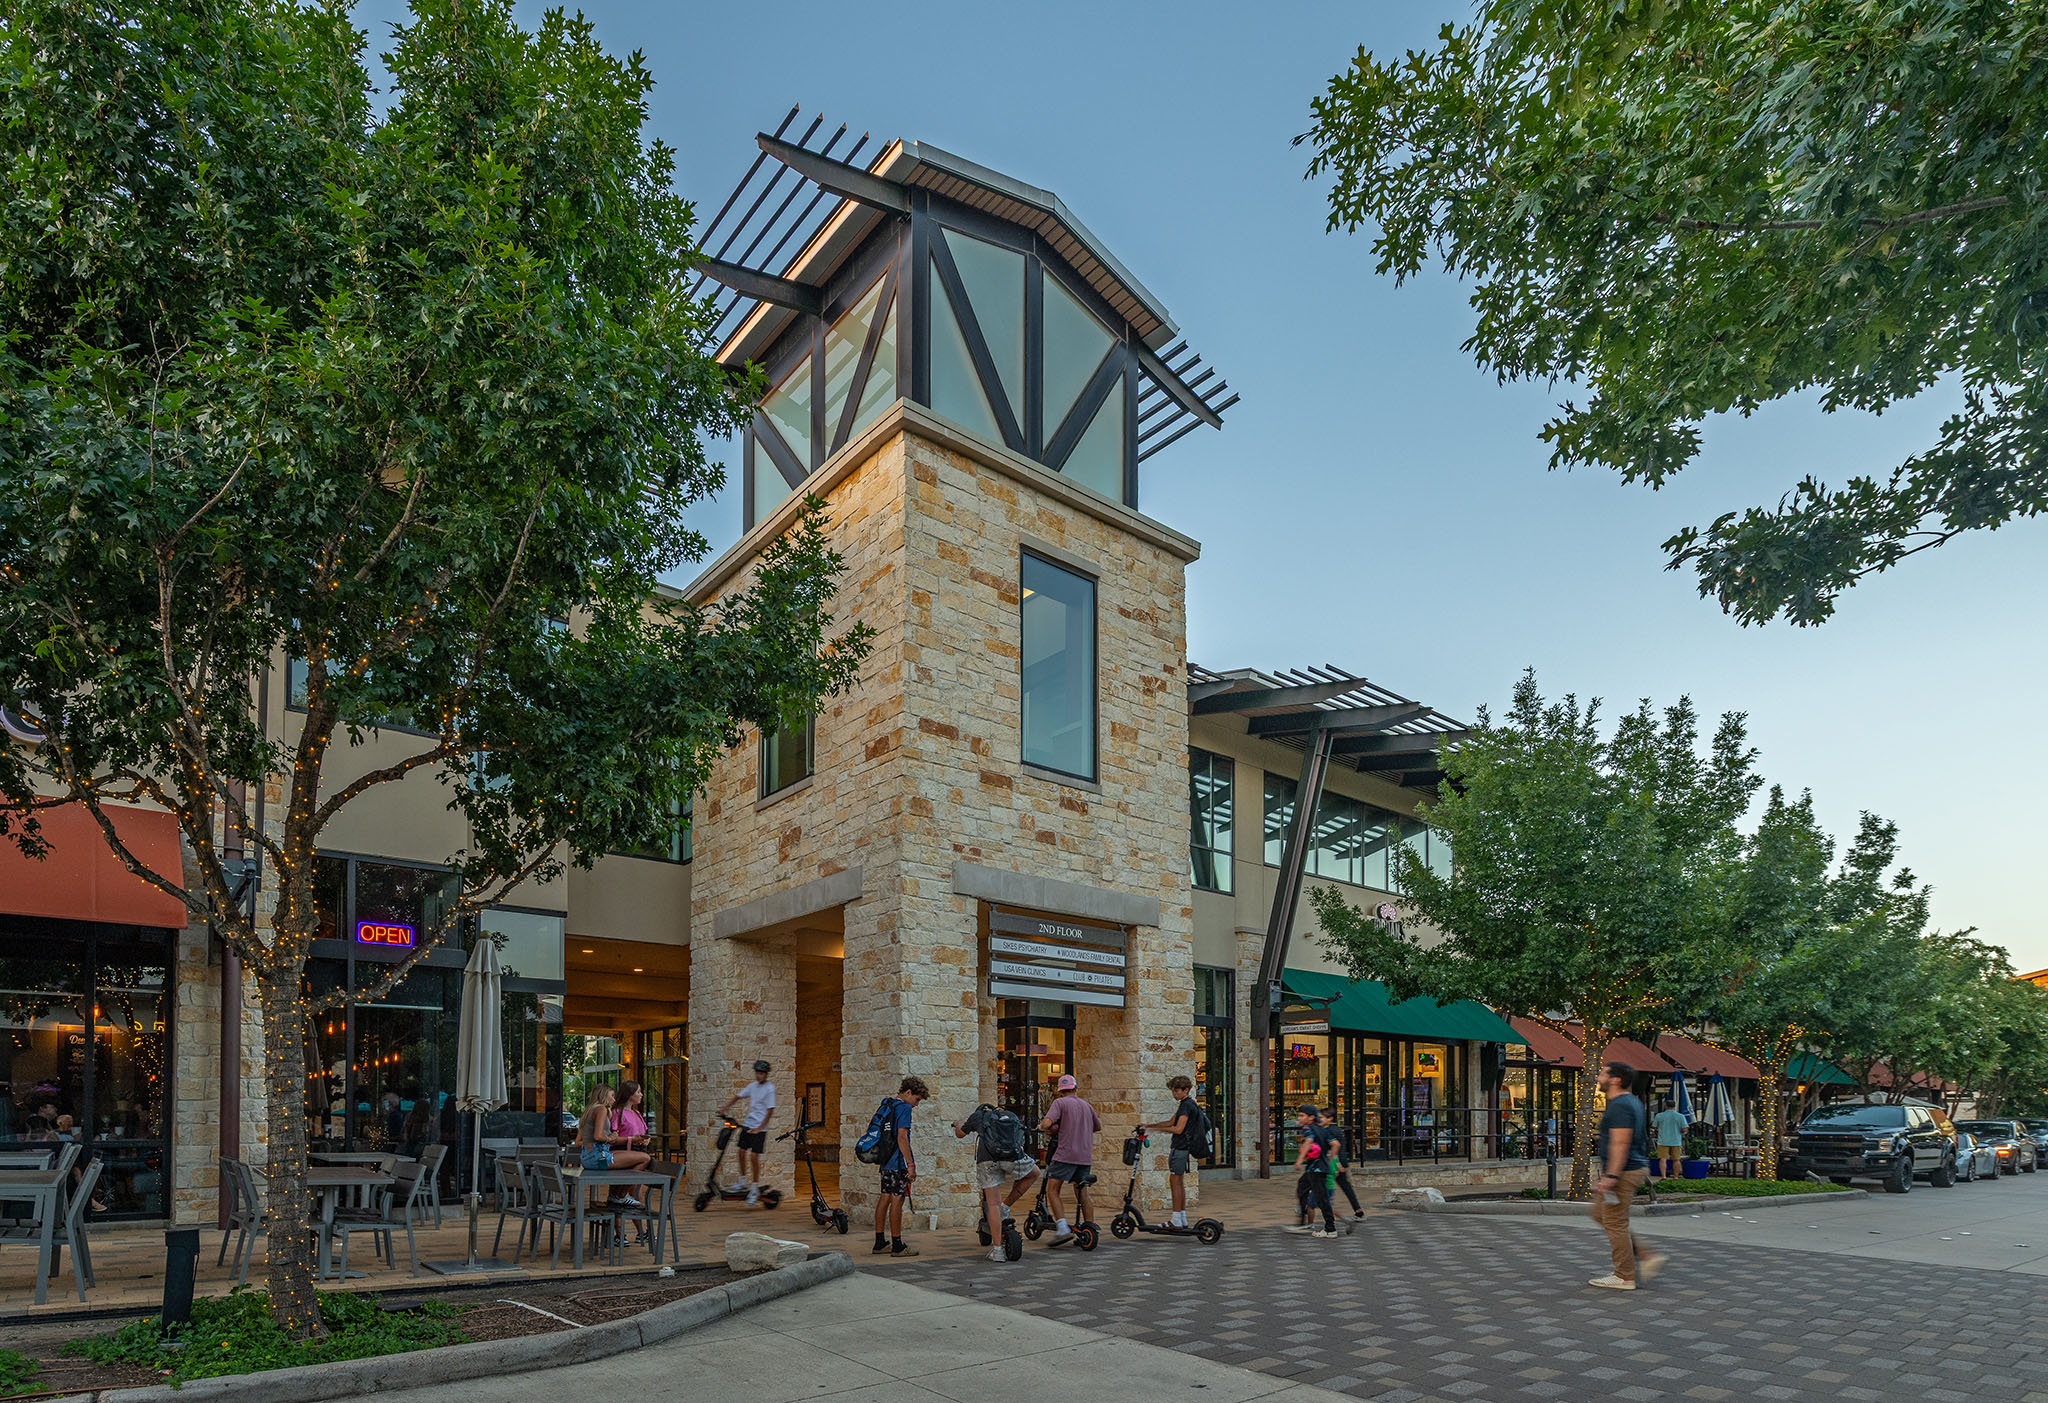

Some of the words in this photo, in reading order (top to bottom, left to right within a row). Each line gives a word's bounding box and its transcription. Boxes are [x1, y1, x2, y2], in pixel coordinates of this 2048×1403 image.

[360, 925, 410, 945] OPEN
[1038, 923, 1056, 935] 2ND
[1056, 926, 1083, 939] FLOOR
[1002, 941, 1018, 951] SIKES
[1018, 942, 1048, 954] PSYCHIATRY
[1060, 949, 1090, 961] WOODLANDS
[1090, 953, 1106, 962] FAMILY
[1105, 954, 1122, 965] DENTAL
[1003, 964, 1015, 973] USA
[1015, 966, 1027, 975] VEIN
[1027, 967, 1047, 977] CLINICS
[1072, 972, 1086, 982] CLUB
[1093, 975, 1113, 985] PILATES
[1300, 1045, 1312, 1054] ICE
